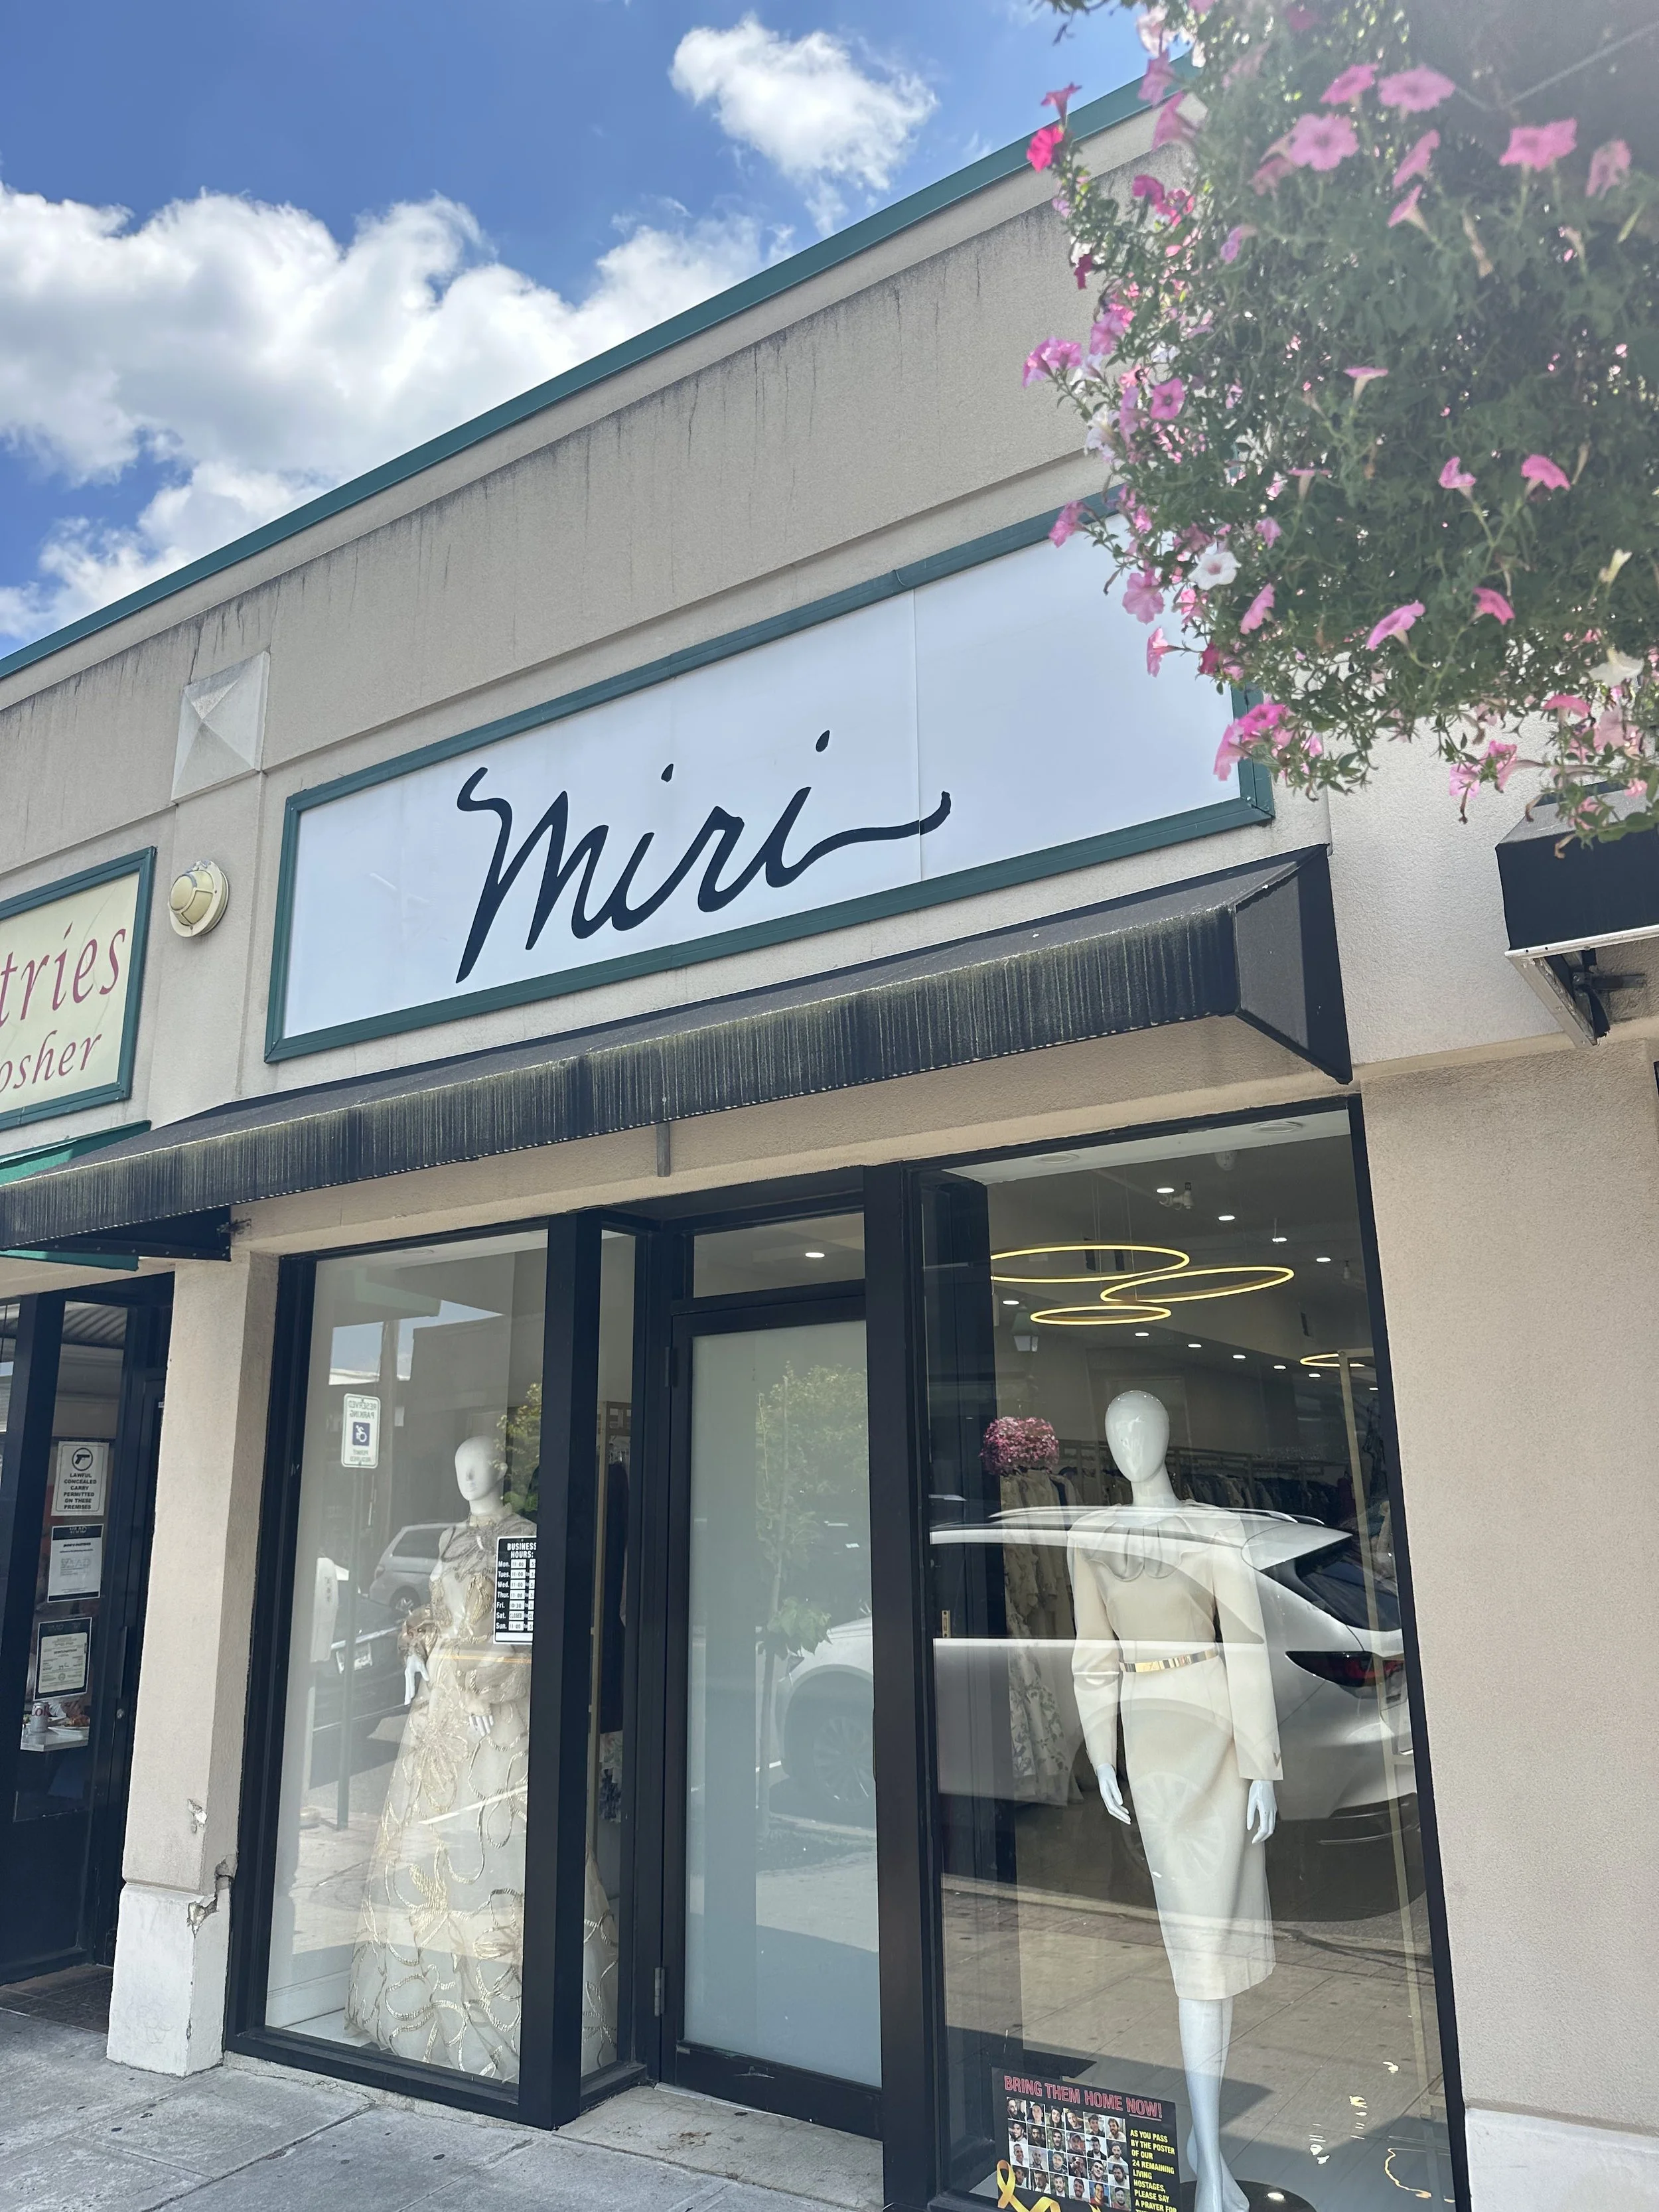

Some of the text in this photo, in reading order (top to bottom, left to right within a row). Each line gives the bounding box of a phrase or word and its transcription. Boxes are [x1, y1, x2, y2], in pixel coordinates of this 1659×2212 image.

[507, 1542, 537, 1551] BUSINESS
[1004, 2075, 1163, 2118] BRING THEM HOME NOW!
[1139, 2130, 1151, 2140] YOU
[1152, 2133, 1168, 2143] PASS
[1139, 2140, 1152, 2150] THE
[1153, 2143, 1175, 2155] POSTER
[1140, 2151, 1153, 2160] OUR
[1133, 2169, 1153, 2179] LIVING
[1141, 2161, 1175, 2175] REMAINING
[1133, 2179, 1166, 2193] HOSTAGES,
[1134, 2189, 1169, 2203] PLEASE SAY
[1141, 2200, 1164, 2212] PRAYER
